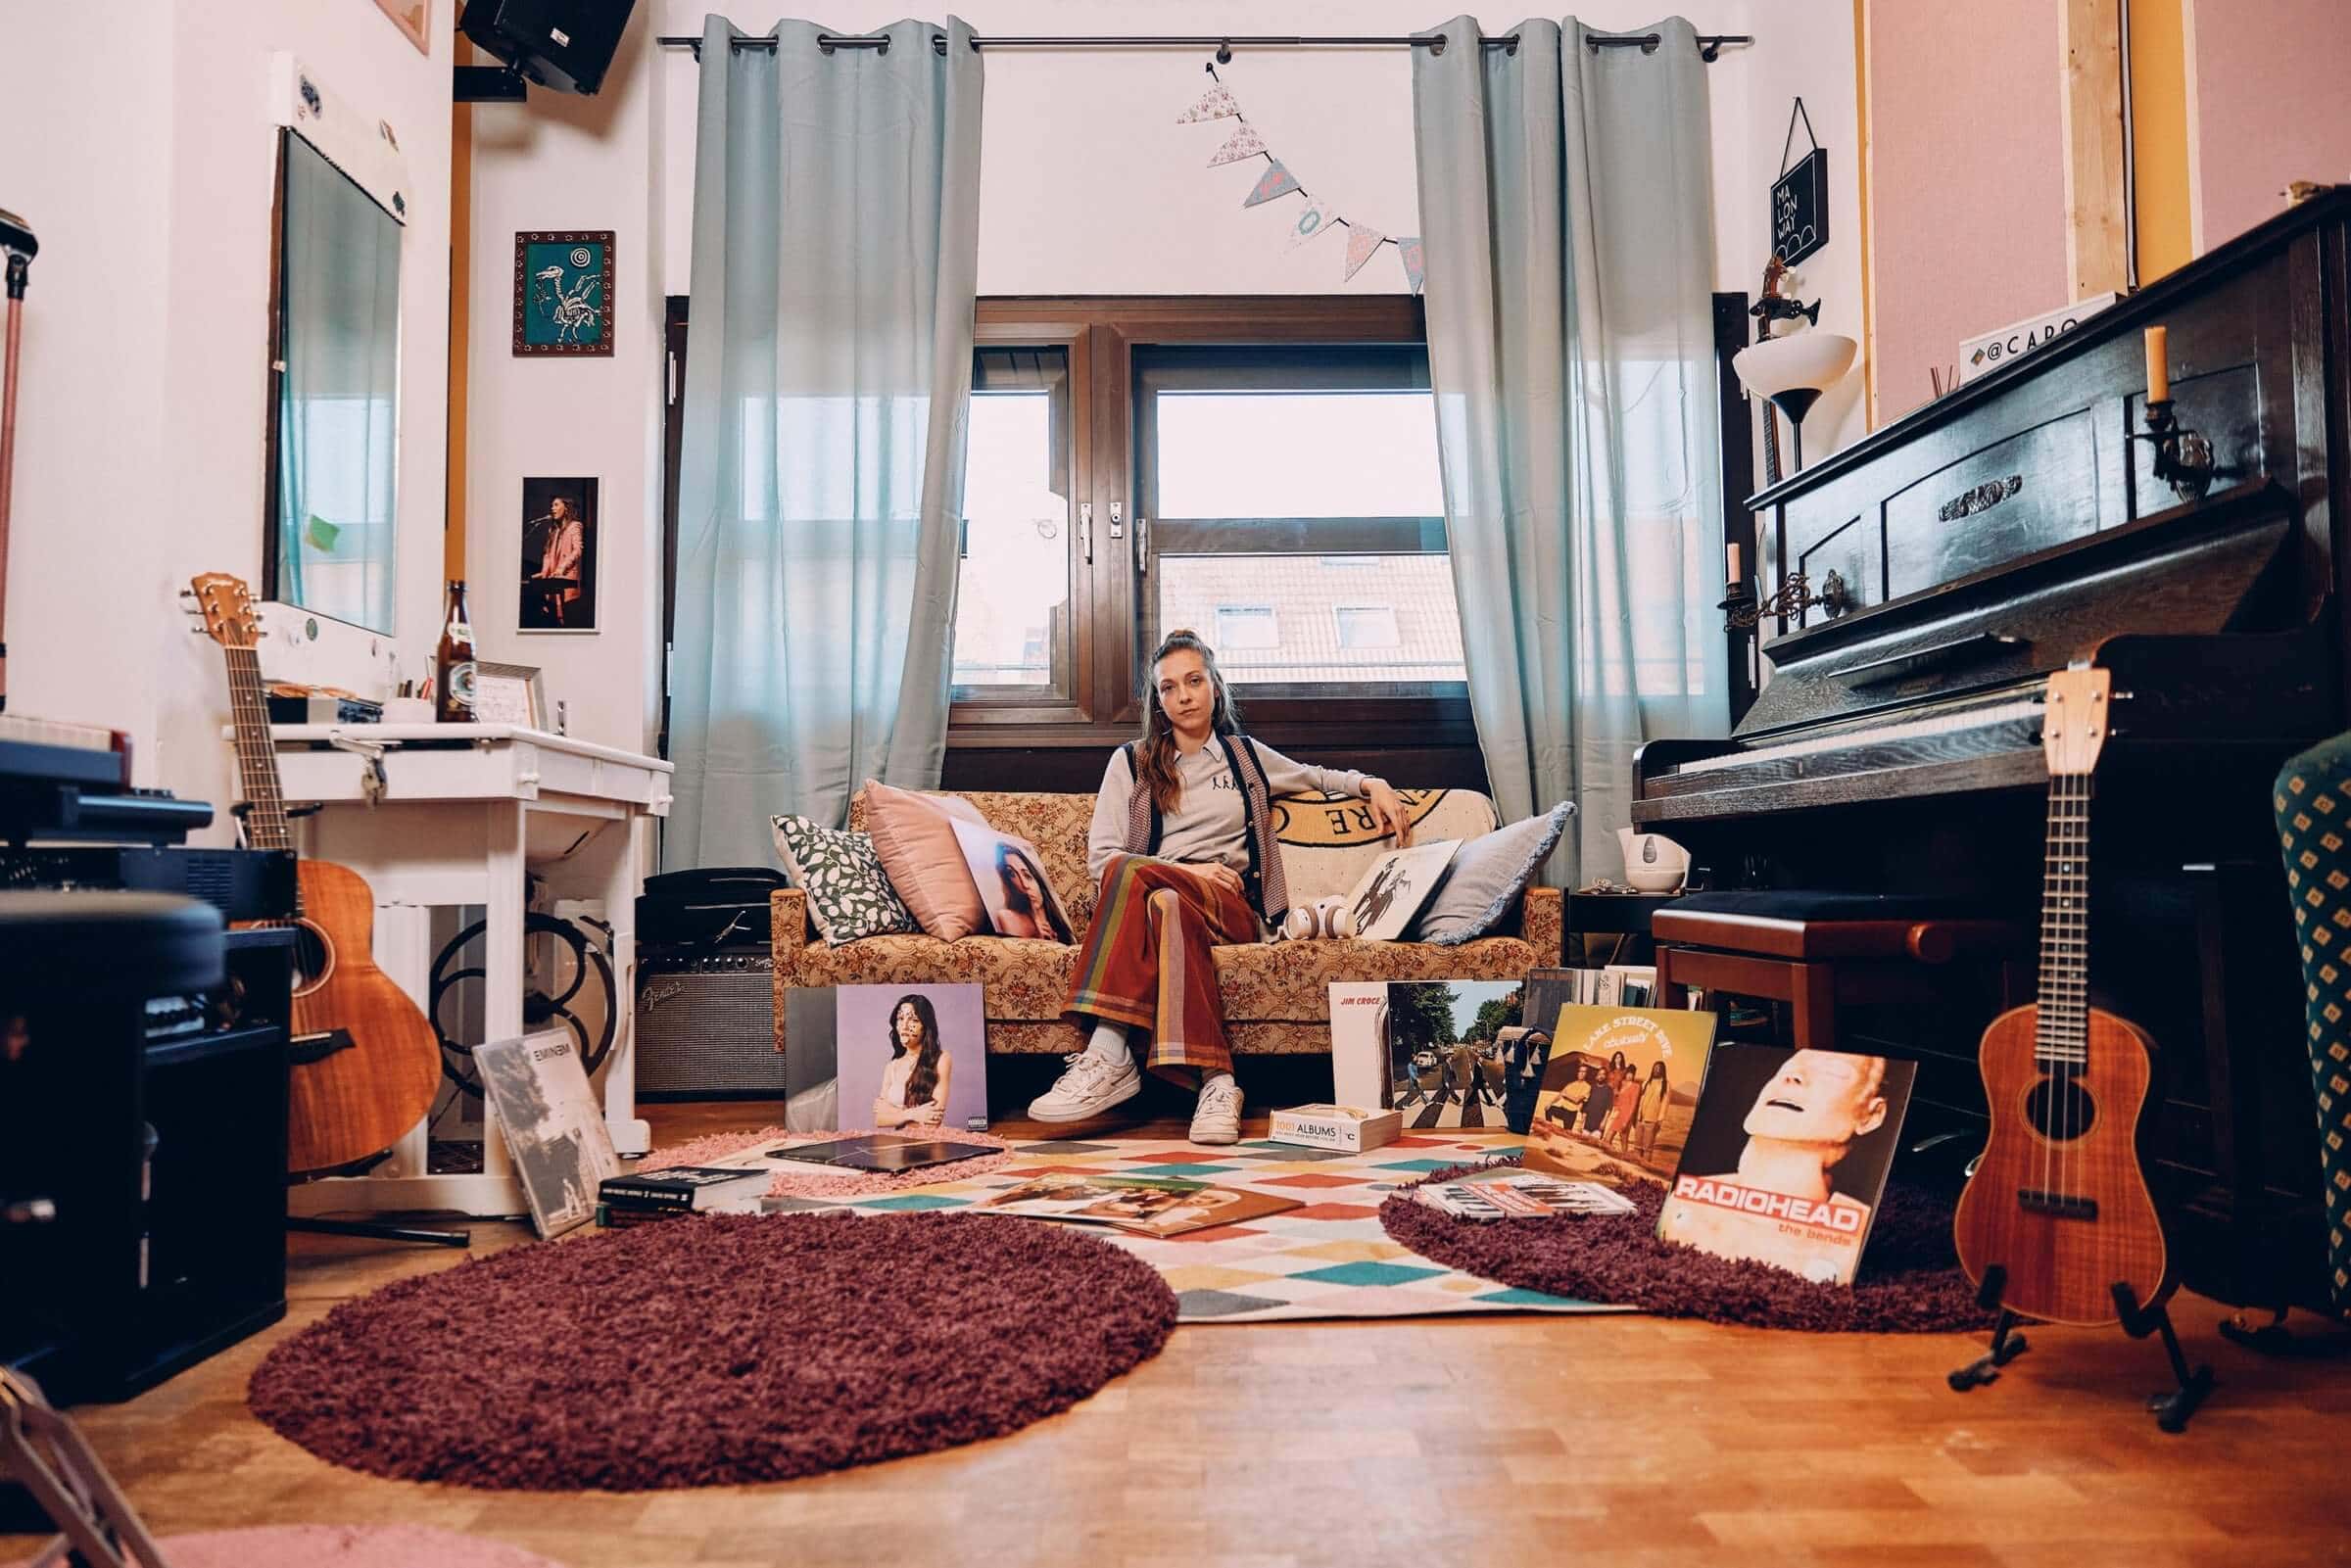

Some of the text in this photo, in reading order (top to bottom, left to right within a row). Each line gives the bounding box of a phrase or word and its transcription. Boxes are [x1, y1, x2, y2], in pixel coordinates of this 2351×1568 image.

[1777, 184, 1791, 205] MA
[1778, 194, 1798, 224] LON
[1778, 214, 1796, 240] WAY
[642, 980, 687, 1012] Fender
[1341, 996, 1381, 1005] JIM CROCE
[1613, 1016, 1659, 1033] STREET
[1296, 1123, 1336, 1137] ALBUMS
[1676, 1176, 1859, 1233] RADIOHEAD
[1778, 1223, 1851, 1247] the bends
